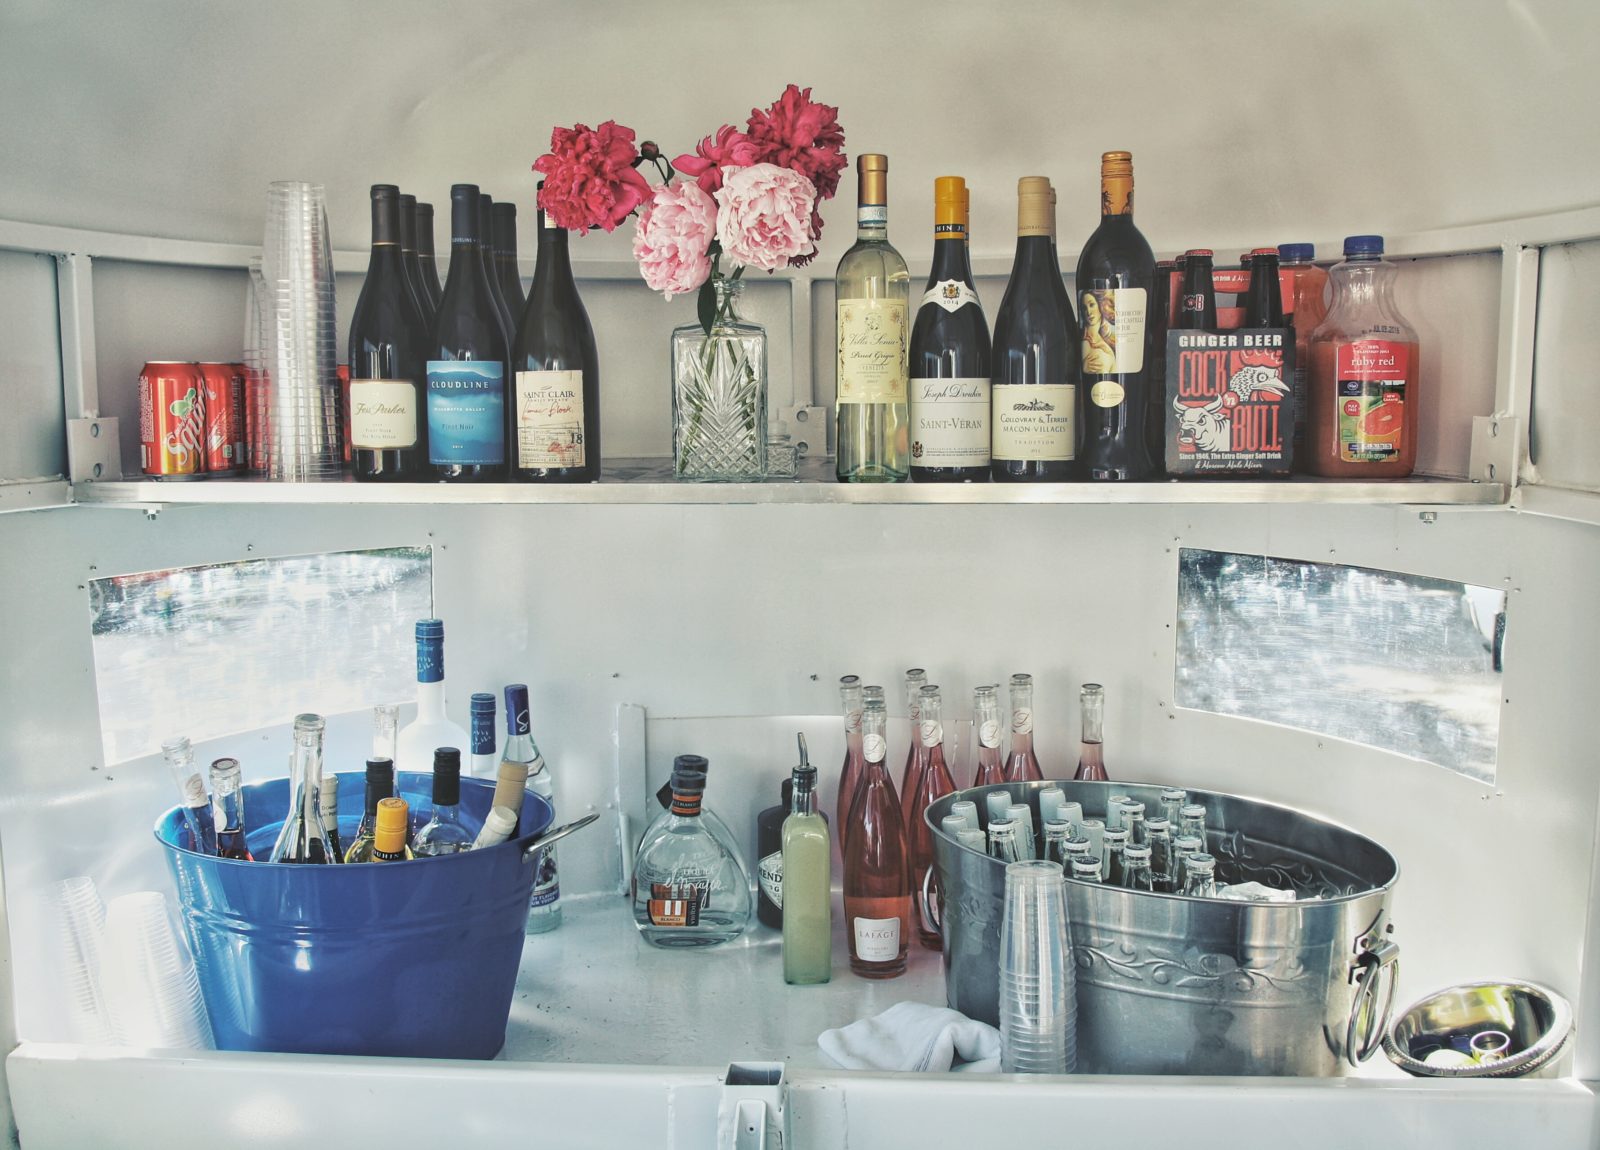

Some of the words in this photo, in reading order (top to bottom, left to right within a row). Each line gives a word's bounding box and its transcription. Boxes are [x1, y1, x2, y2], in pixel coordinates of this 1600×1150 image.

[1178, 335, 1238, 347] GINGER
[1243, 335, 1283, 347] BEER
[1351, 355, 1376, 368] ruby
[1378, 355, 1395, 366] red
[1179, 350, 1229, 397] COCK
[431, 381, 489, 389] CLOUDLINE
[523, 391, 546, 399] SAINT
[548, 390, 576, 398] CLAIR
[921, 384, 947, 402] Joseph
[948, 383, 982, 398] Drouhin
[370, 402, 408, 416] Parker
[1033, 425, 1066, 433] VILLAGES
[1231, 405, 1281, 452] BULL
[1235, 453, 1254, 461] Ginger
[1201, 460, 1226, 470] Moscow
[1226, 460, 1243, 470] Mule
[1243, 460, 1263, 470] Mixer
[859, 930, 896, 939] LAFAGE
